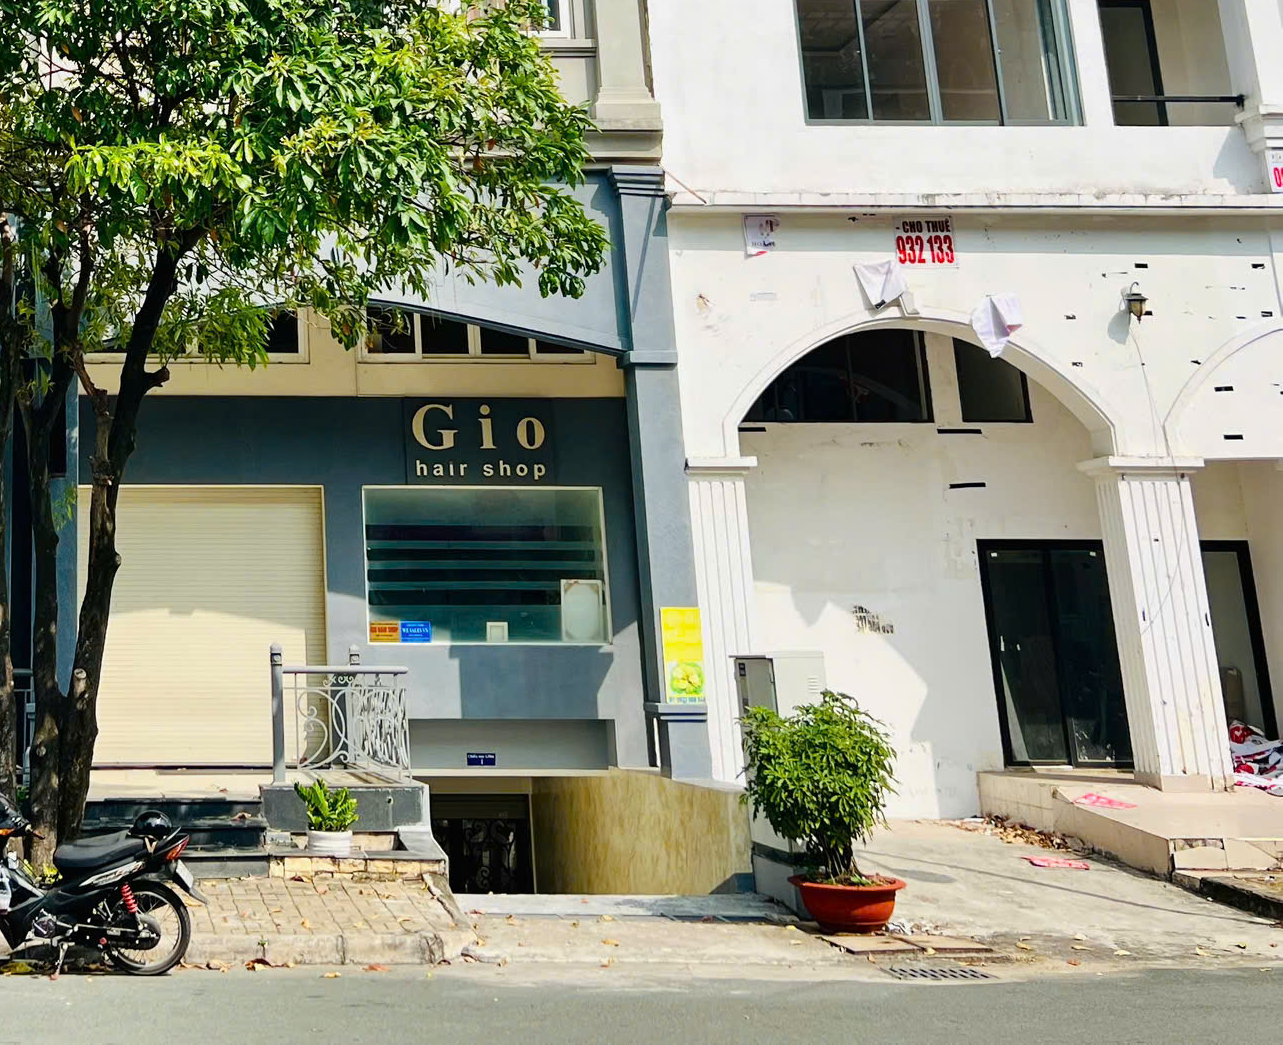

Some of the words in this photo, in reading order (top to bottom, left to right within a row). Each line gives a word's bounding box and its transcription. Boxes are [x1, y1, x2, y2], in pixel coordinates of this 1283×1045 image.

[902, 220, 923, 233] CHO
[925, 218, 951, 233] THUÊ
[896, 235, 925, 264] 932
[926, 234, 954, 264] 133
[412, 404, 545, 450] Gio
[416, 460, 467, 476] hair
[482, 460, 546, 480] shop
